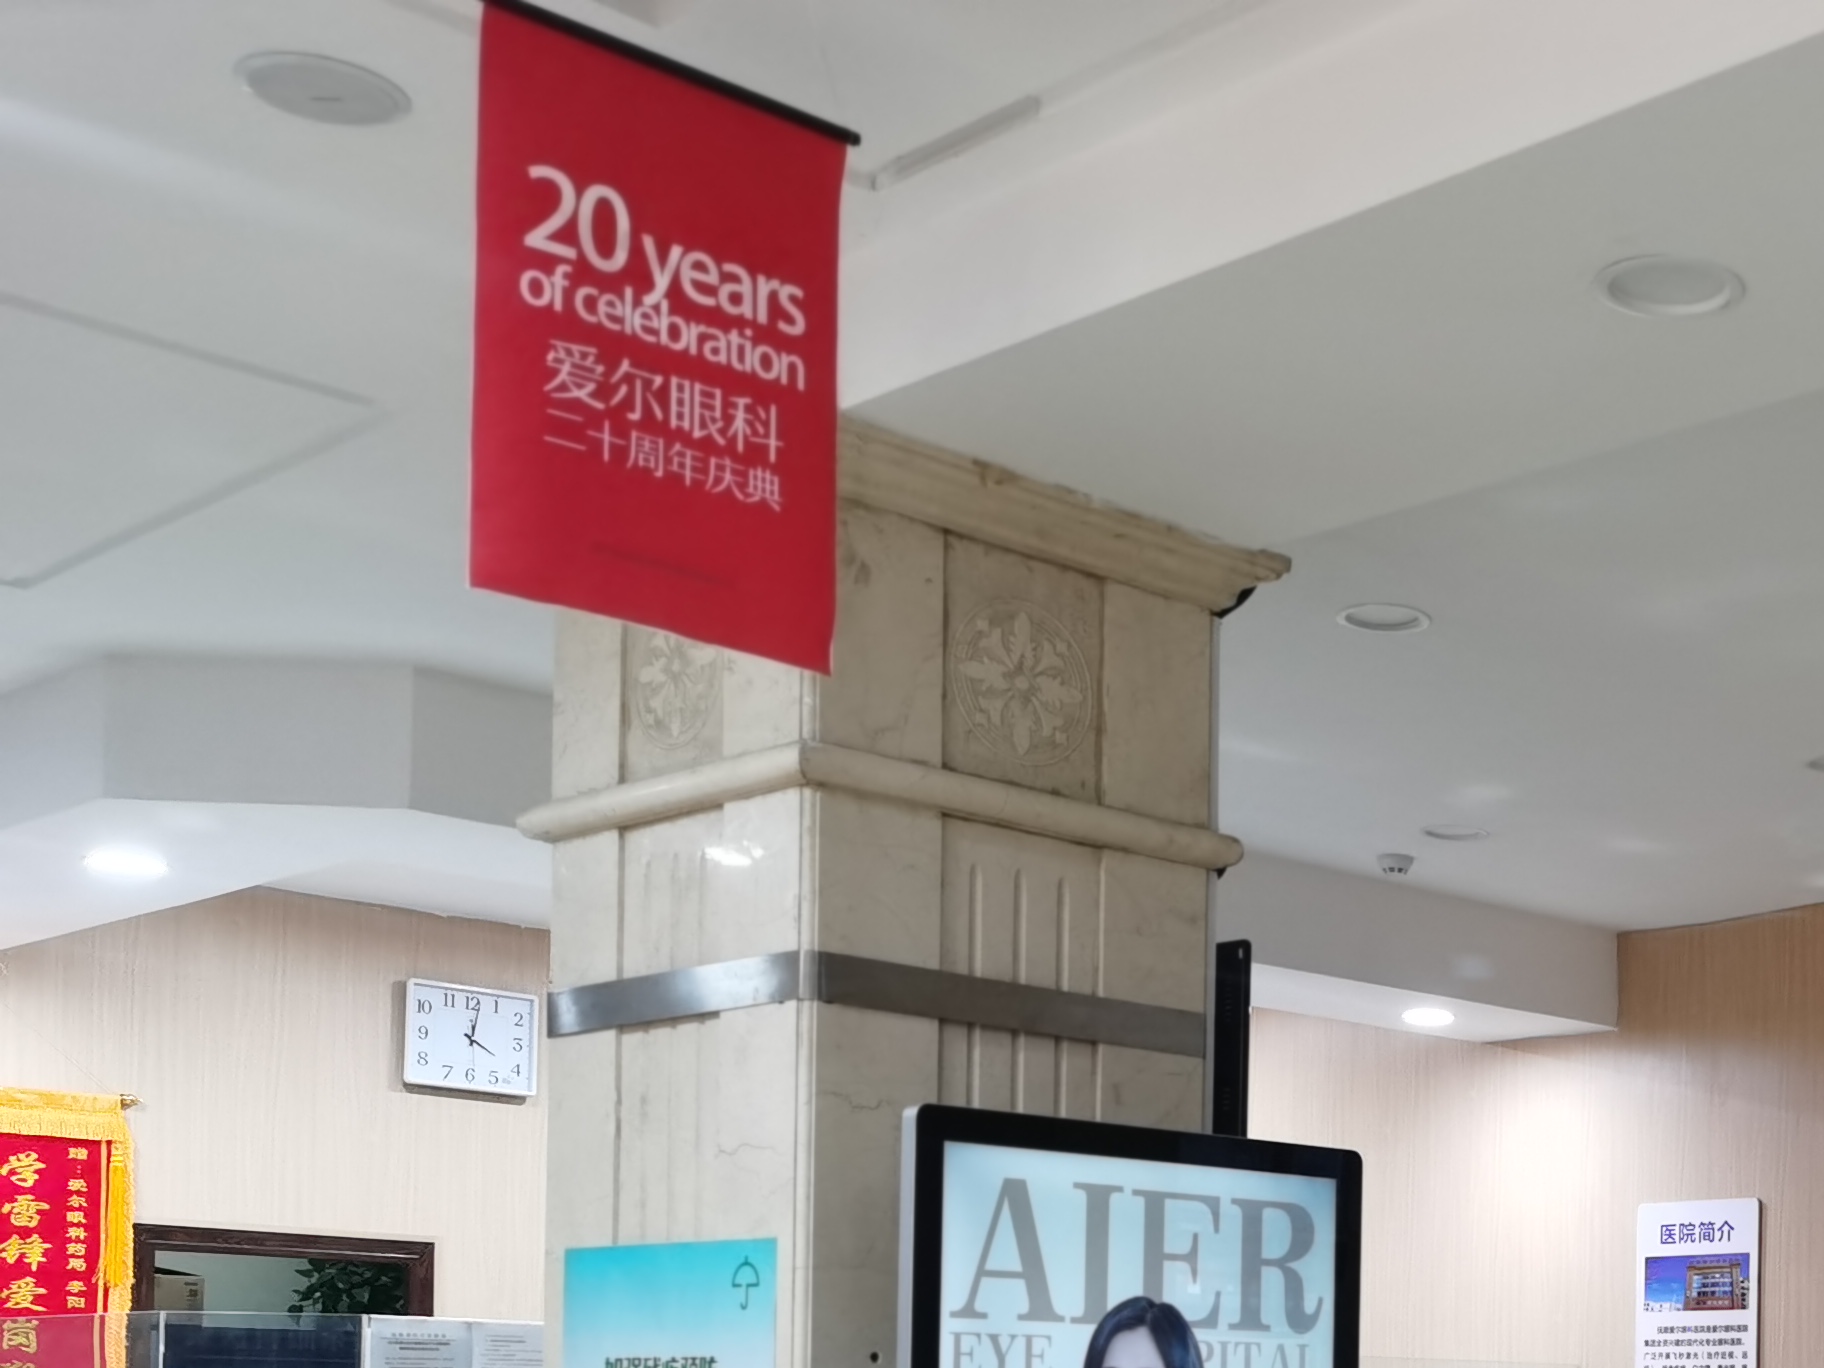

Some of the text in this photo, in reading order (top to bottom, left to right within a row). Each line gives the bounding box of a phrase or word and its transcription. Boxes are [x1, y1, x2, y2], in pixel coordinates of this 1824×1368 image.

[523, 164, 805, 337] 20 years
[519, 264, 805, 391] of celebration
[543, 339, 784, 464] 爱尔眼科
[543, 408, 783, 512] 二十周年庆典
[417, 999, 432, 1015] 10
[443, 993, 455, 1008] 11
[465, 995, 480, 1011] 12
[493, 1000, 499, 1014] 1
[513, 1012, 524, 1027] 2
[418, 1025, 428, 1040] 9
[512, 1037, 523, 1052] 3
[417, 1051, 428, 1066] 8
[442, 1064, 454, 1081] 7
[465, 1068, 476, 1082] 6
[488, 1070, 499, 1085] 5
[510, 1064, 521, 1077] 4
[1659, 1220, 1735, 1245] 医院简介
[949, 1177, 1323, 1334] AIER
